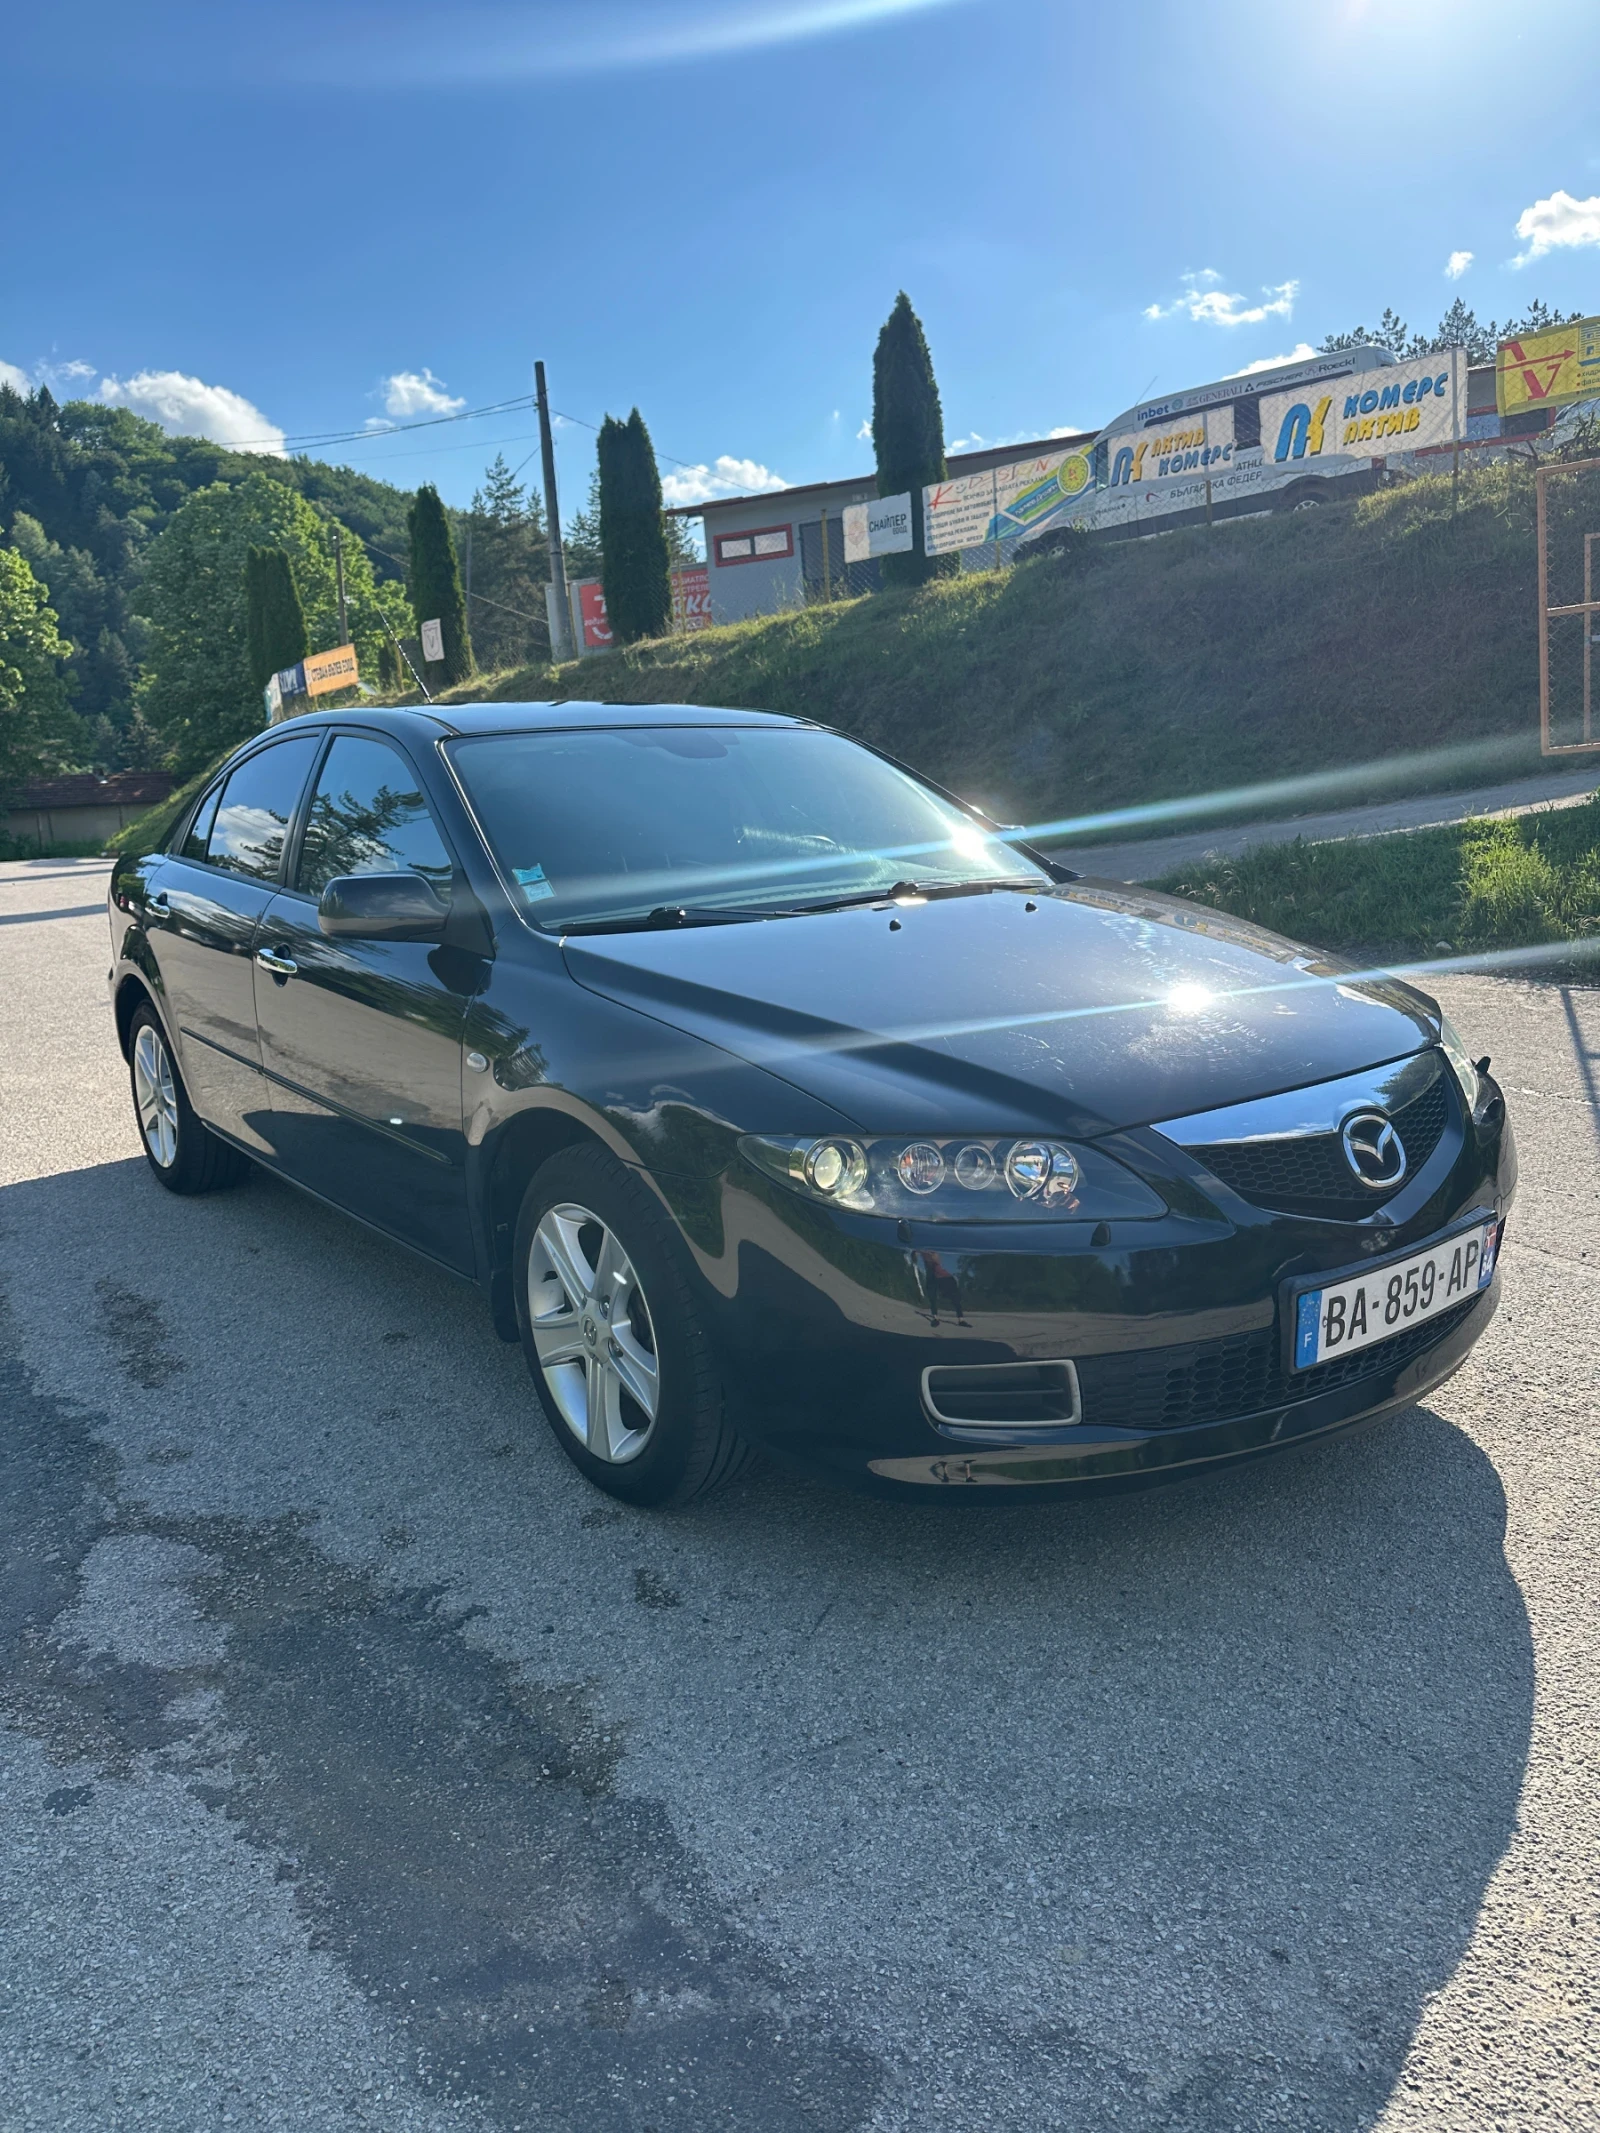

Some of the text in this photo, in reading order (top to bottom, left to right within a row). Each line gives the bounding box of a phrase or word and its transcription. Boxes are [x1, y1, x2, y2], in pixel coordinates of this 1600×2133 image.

[1319, 357, 1355, 373] Roeckl
[1256, 372, 1303, 388] FISCHER
[1200, 386, 1242, 403] GENERALI
[1343, 372, 1448, 419] КОМЕРС
[1137, 405, 1169, 421] inbet
[1158, 443, 1233, 476] КОМЕРС
[1170, 480, 1224, 498] БЪЛГАРКА
[869, 514, 906, 532] СНАЙПЕР
[1325, 1239, 1479, 1348] BA-859-AP
[1304, 1332, 1312, 1348] F
